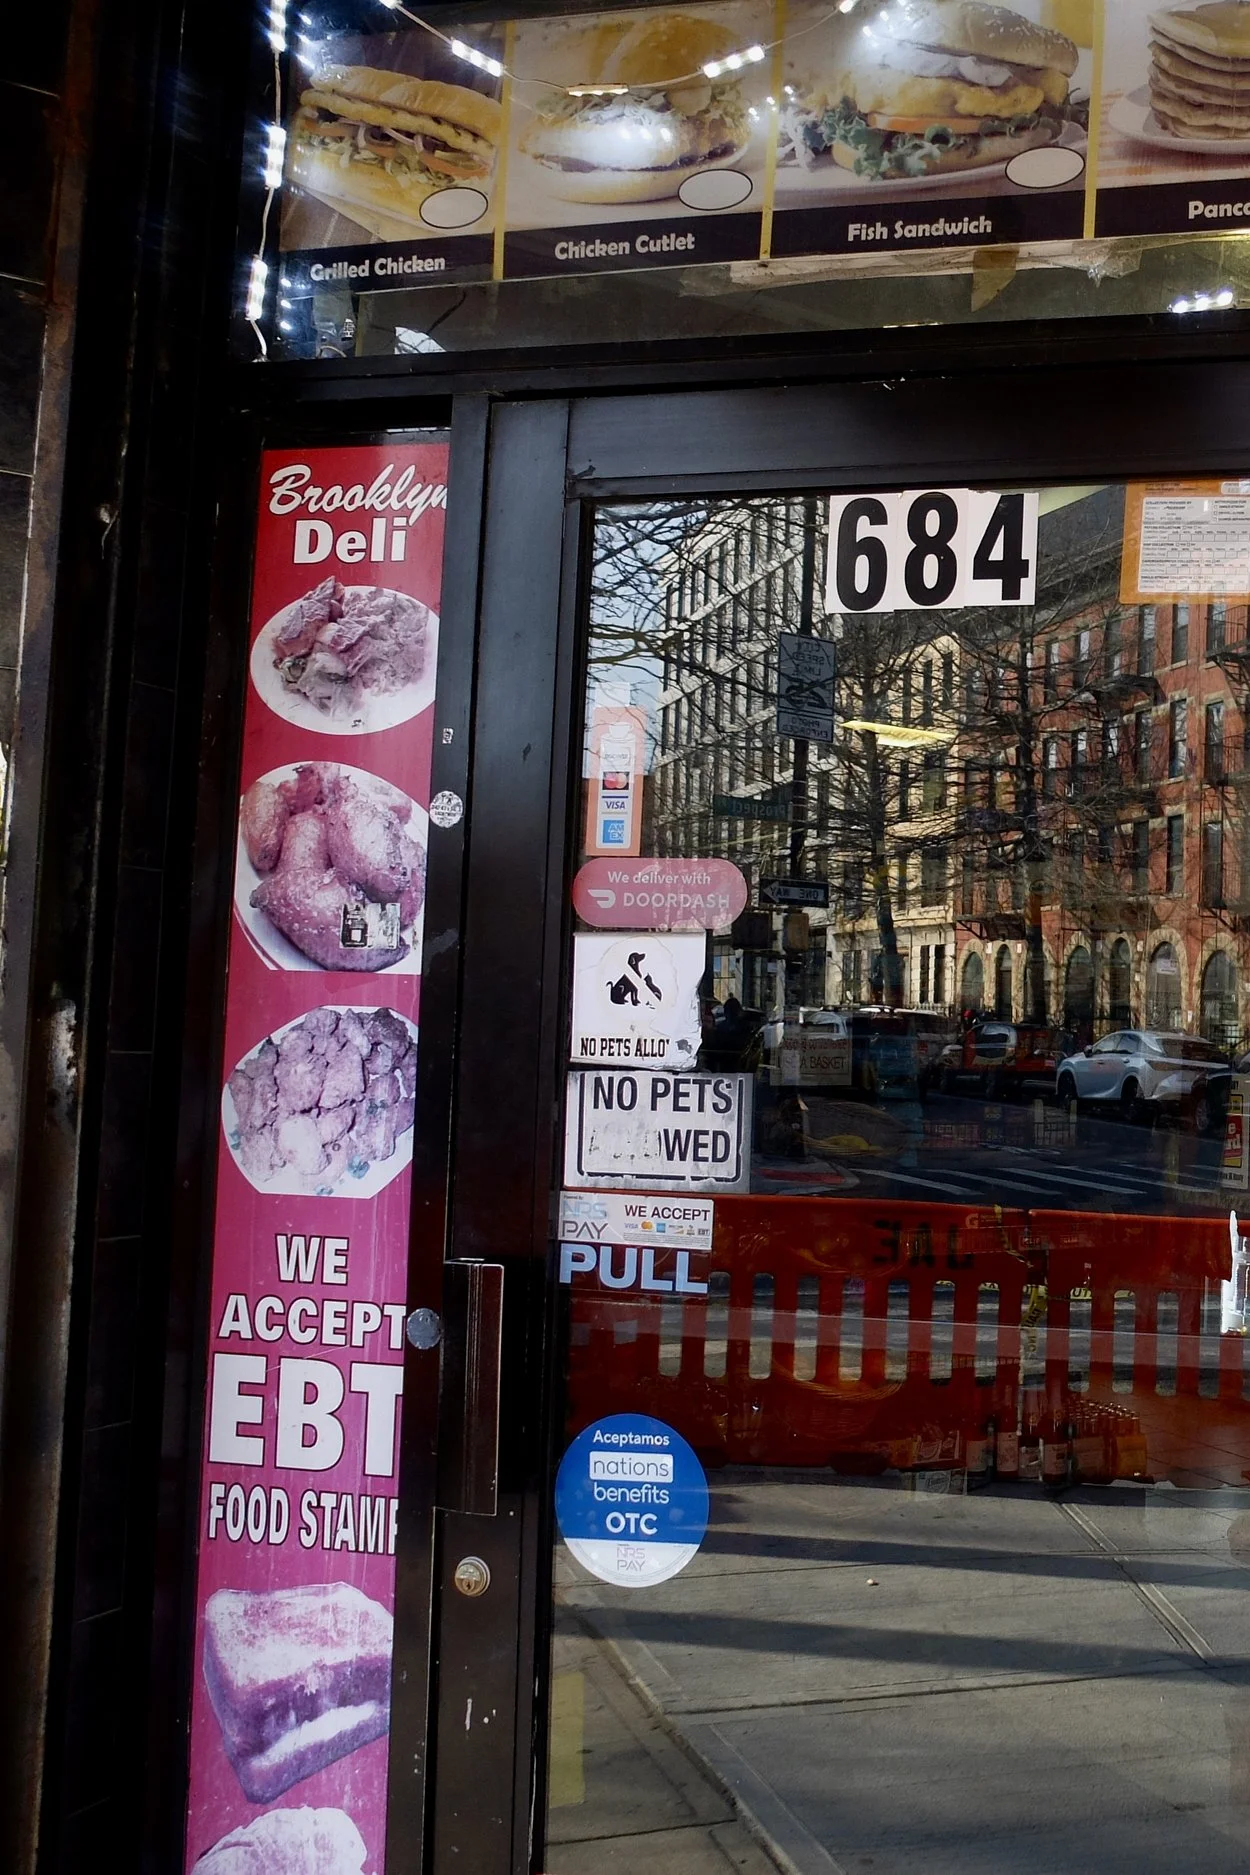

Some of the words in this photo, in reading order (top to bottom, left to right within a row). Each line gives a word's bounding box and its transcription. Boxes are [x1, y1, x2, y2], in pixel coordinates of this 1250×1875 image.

[848, 222, 887, 243] Fish
[894, 216, 993, 240] Sandwich
[553, 239, 630, 261] Chicken
[635, 232, 696, 254] Cutlet
[310, 258, 370, 282] Grilled
[374, 256, 446, 276] Chicken
[268, 463, 448, 526] Brooklyn
[293, 516, 408, 564] Deli
[836, 491, 1030, 612] 684
[605, 801, 626, 809] VISA
[607, 871, 629, 884] We
[632, 871, 679, 885] deliver
[681, 871, 711, 885] with
[623, 892, 730, 909] DOORDASH
[580, 1037, 598, 1057] NO
[600, 1038, 631, 1057] PETS
[634, 1038, 670, 1059] ALLO
[810, 1055, 846, 1069] BASKET
[592, 1075, 638, 1111] NO
[649, 1077, 732, 1114] PETS
[624, 1204, 647, 1218] WE
[651, 1206, 711, 1221] ACCEPT
[562, 1220, 608, 1240] PAY
[275, 1233, 350, 1285] WE
[560, 1243, 708, 1294] PULL
[217, 1293, 407, 1351] ACCEPT
[208, 1351, 405, 1478] EBT
[592, 1429, 671, 1448] Aceptamos
[593, 1457, 669, 1477] nations
[593, 1481, 670, 1505] benefits
[208, 1481, 290, 1546] FOOD
[605, 1511, 658, 1535] OTC
[616, 1547, 645, 1559] NRS
[616, 1559, 647, 1572] PAY
